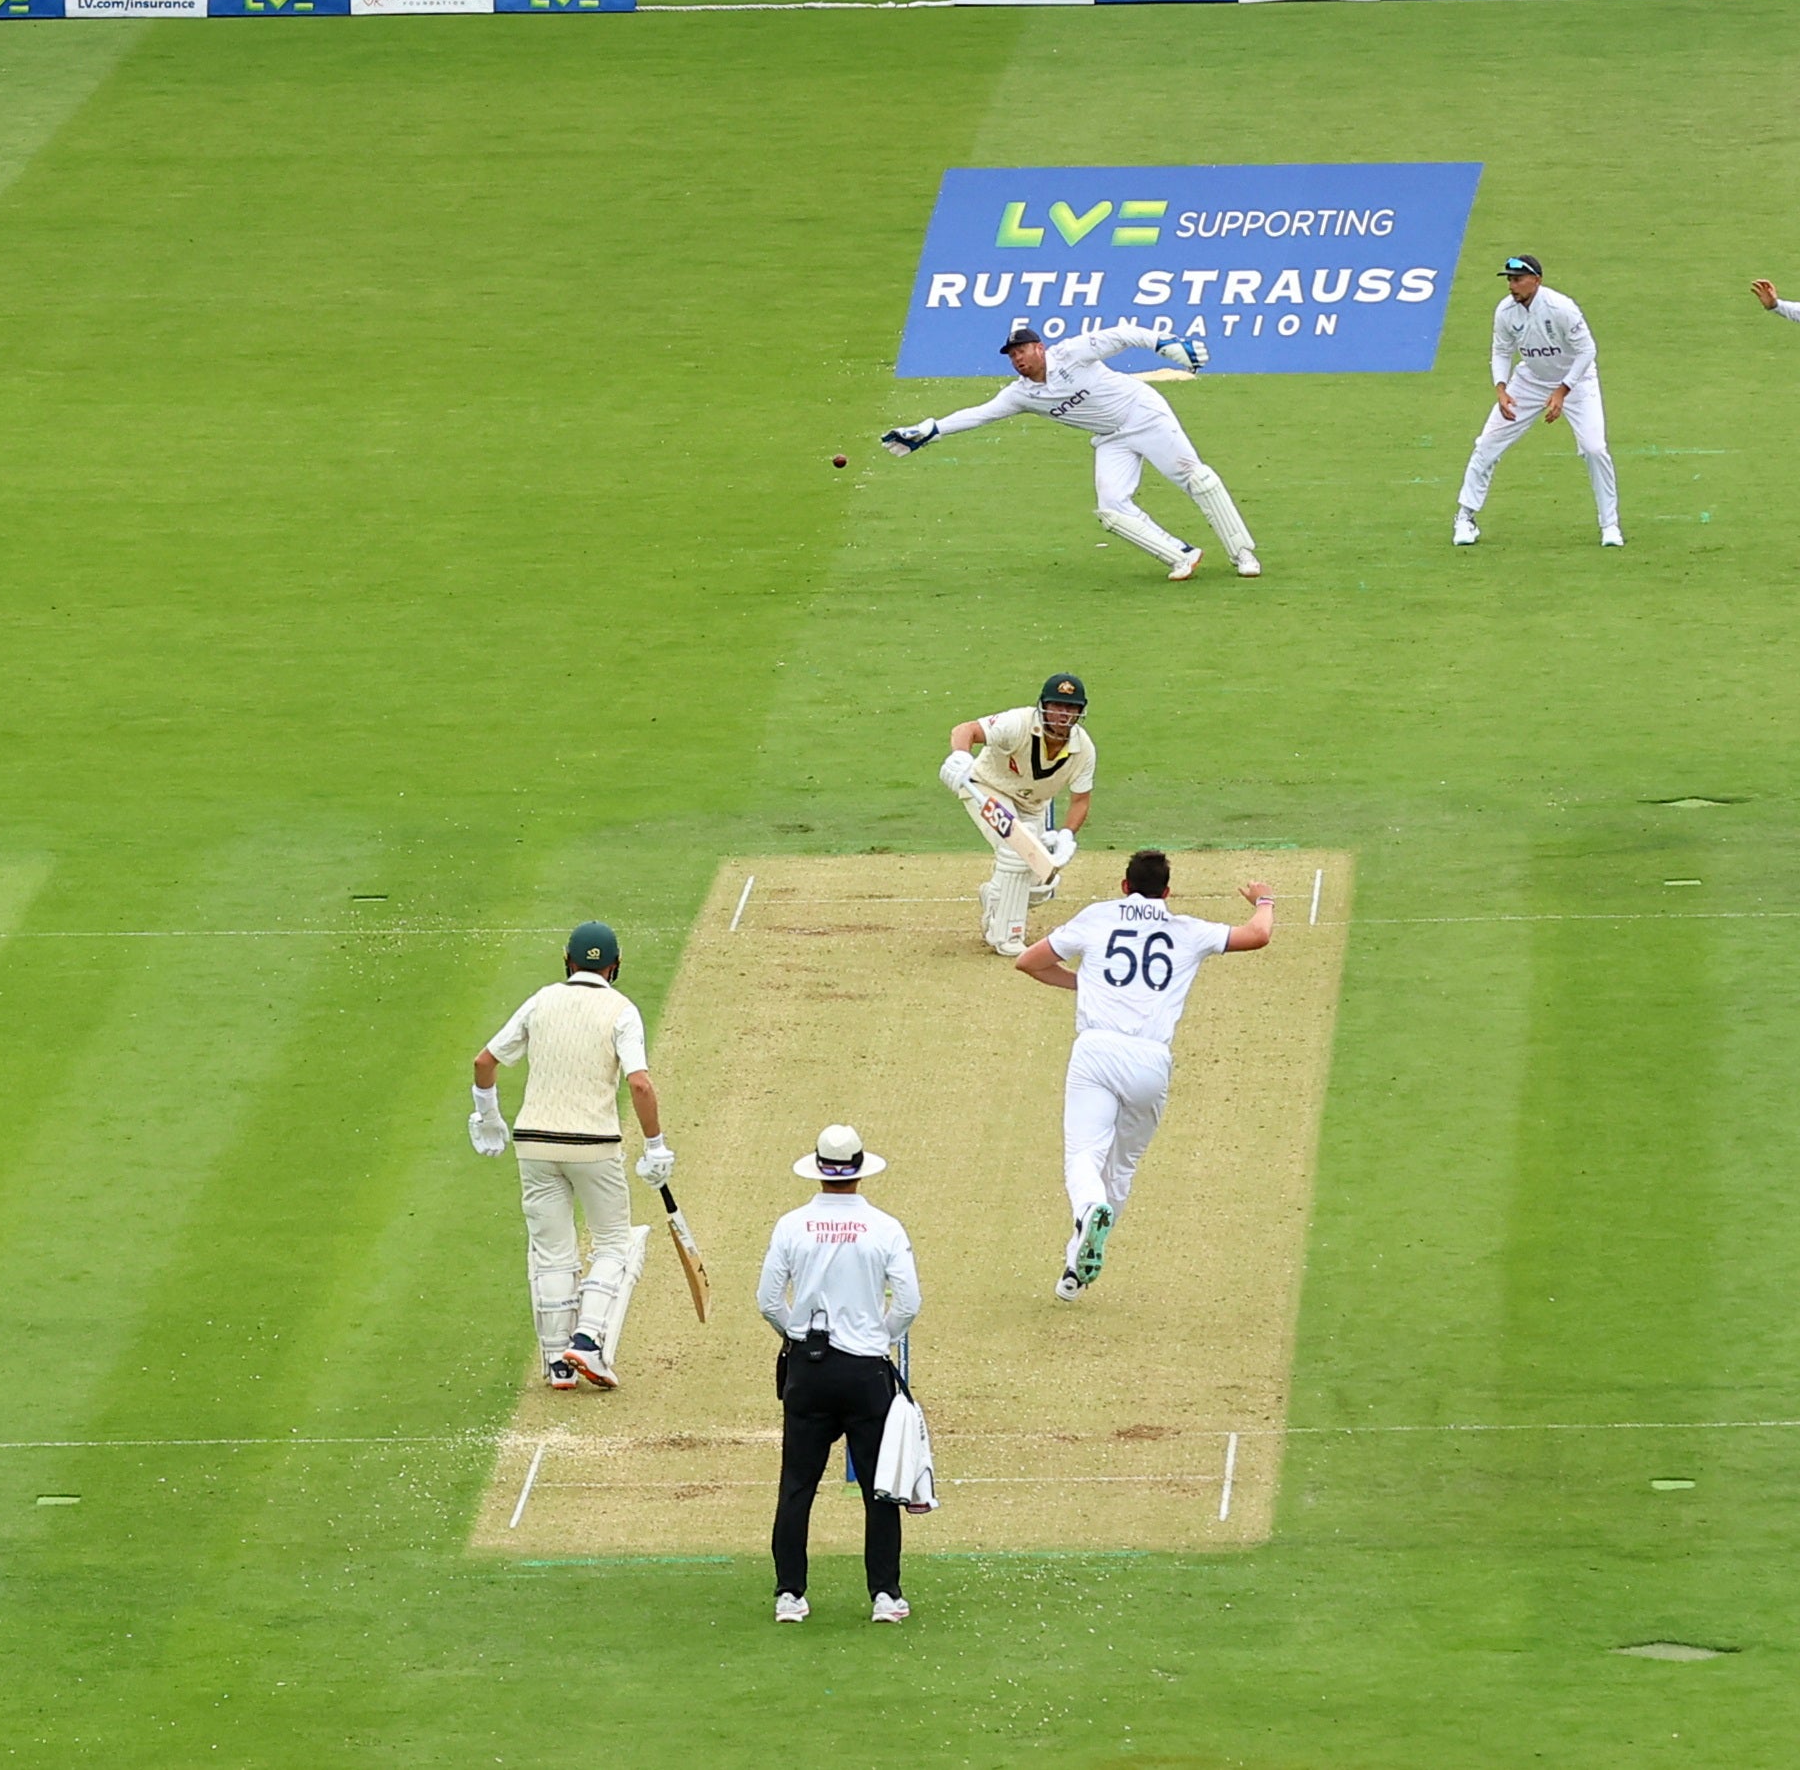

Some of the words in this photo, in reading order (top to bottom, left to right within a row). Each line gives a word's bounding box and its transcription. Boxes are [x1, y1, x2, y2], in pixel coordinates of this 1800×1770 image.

[1176, 208, 1395, 238] SUPPORTING
[926, 271, 1105, 308] RUTH
[1133, 267, 1438, 306] STRAUSS
[1520, 346, 1562, 358] cinch
[1050, 388, 1090, 418] cinch
[1103, 928, 1174, 992] 56
[806, 1219, 868, 1232] Emirates
